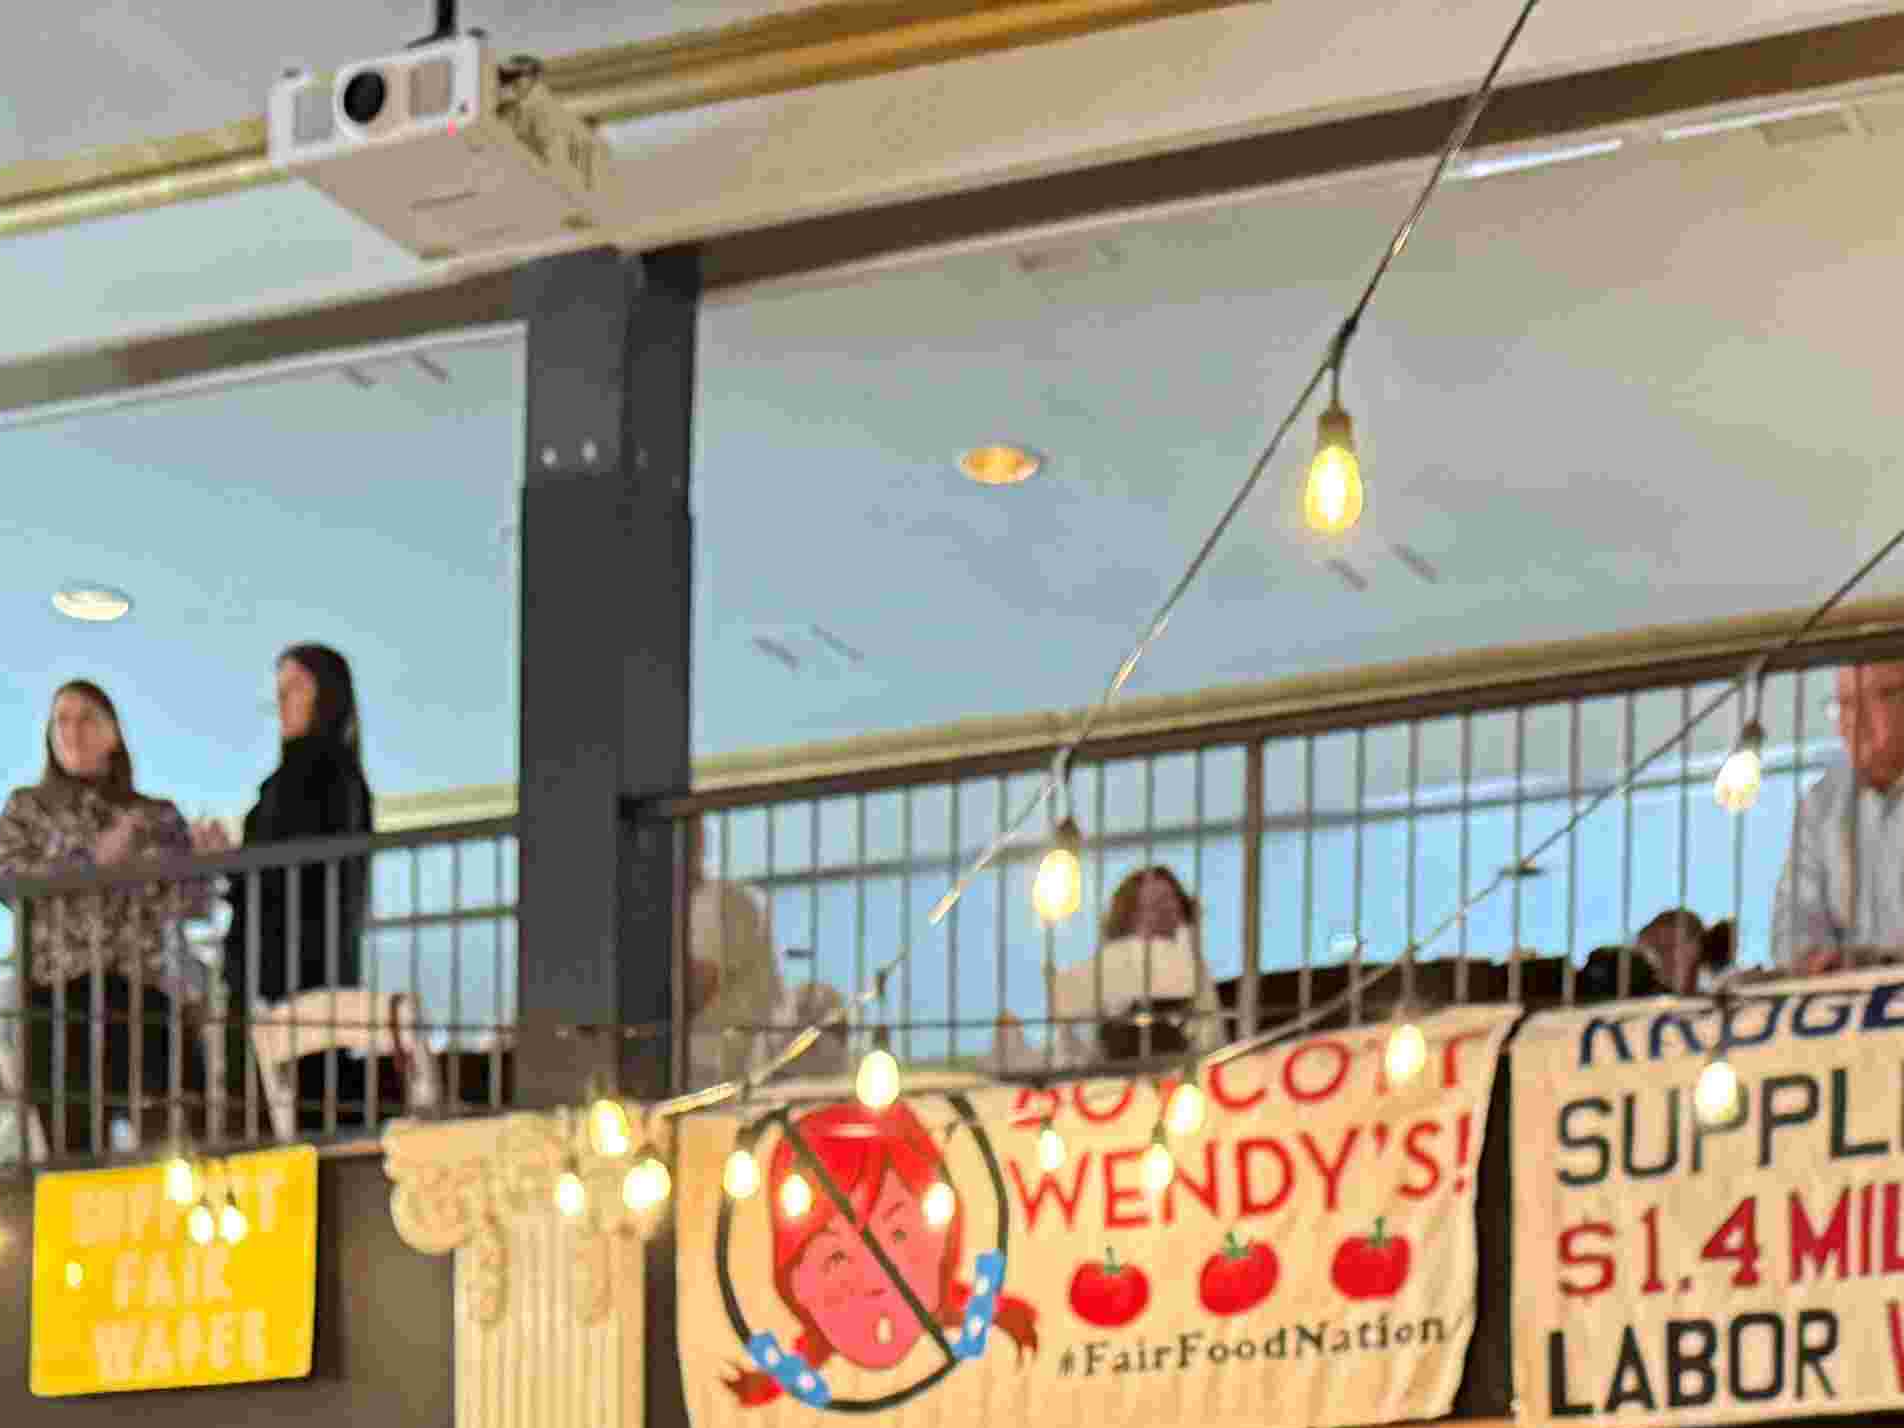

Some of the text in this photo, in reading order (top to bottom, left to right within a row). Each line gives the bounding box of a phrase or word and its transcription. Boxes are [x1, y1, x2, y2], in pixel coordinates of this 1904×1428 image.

[1008, 1112, 1472, 1234] WENDY'S!
[1057, 1311, 1448, 1378] #FairFoodNation
[1548, 1307, 1839, 1418] LABOR
